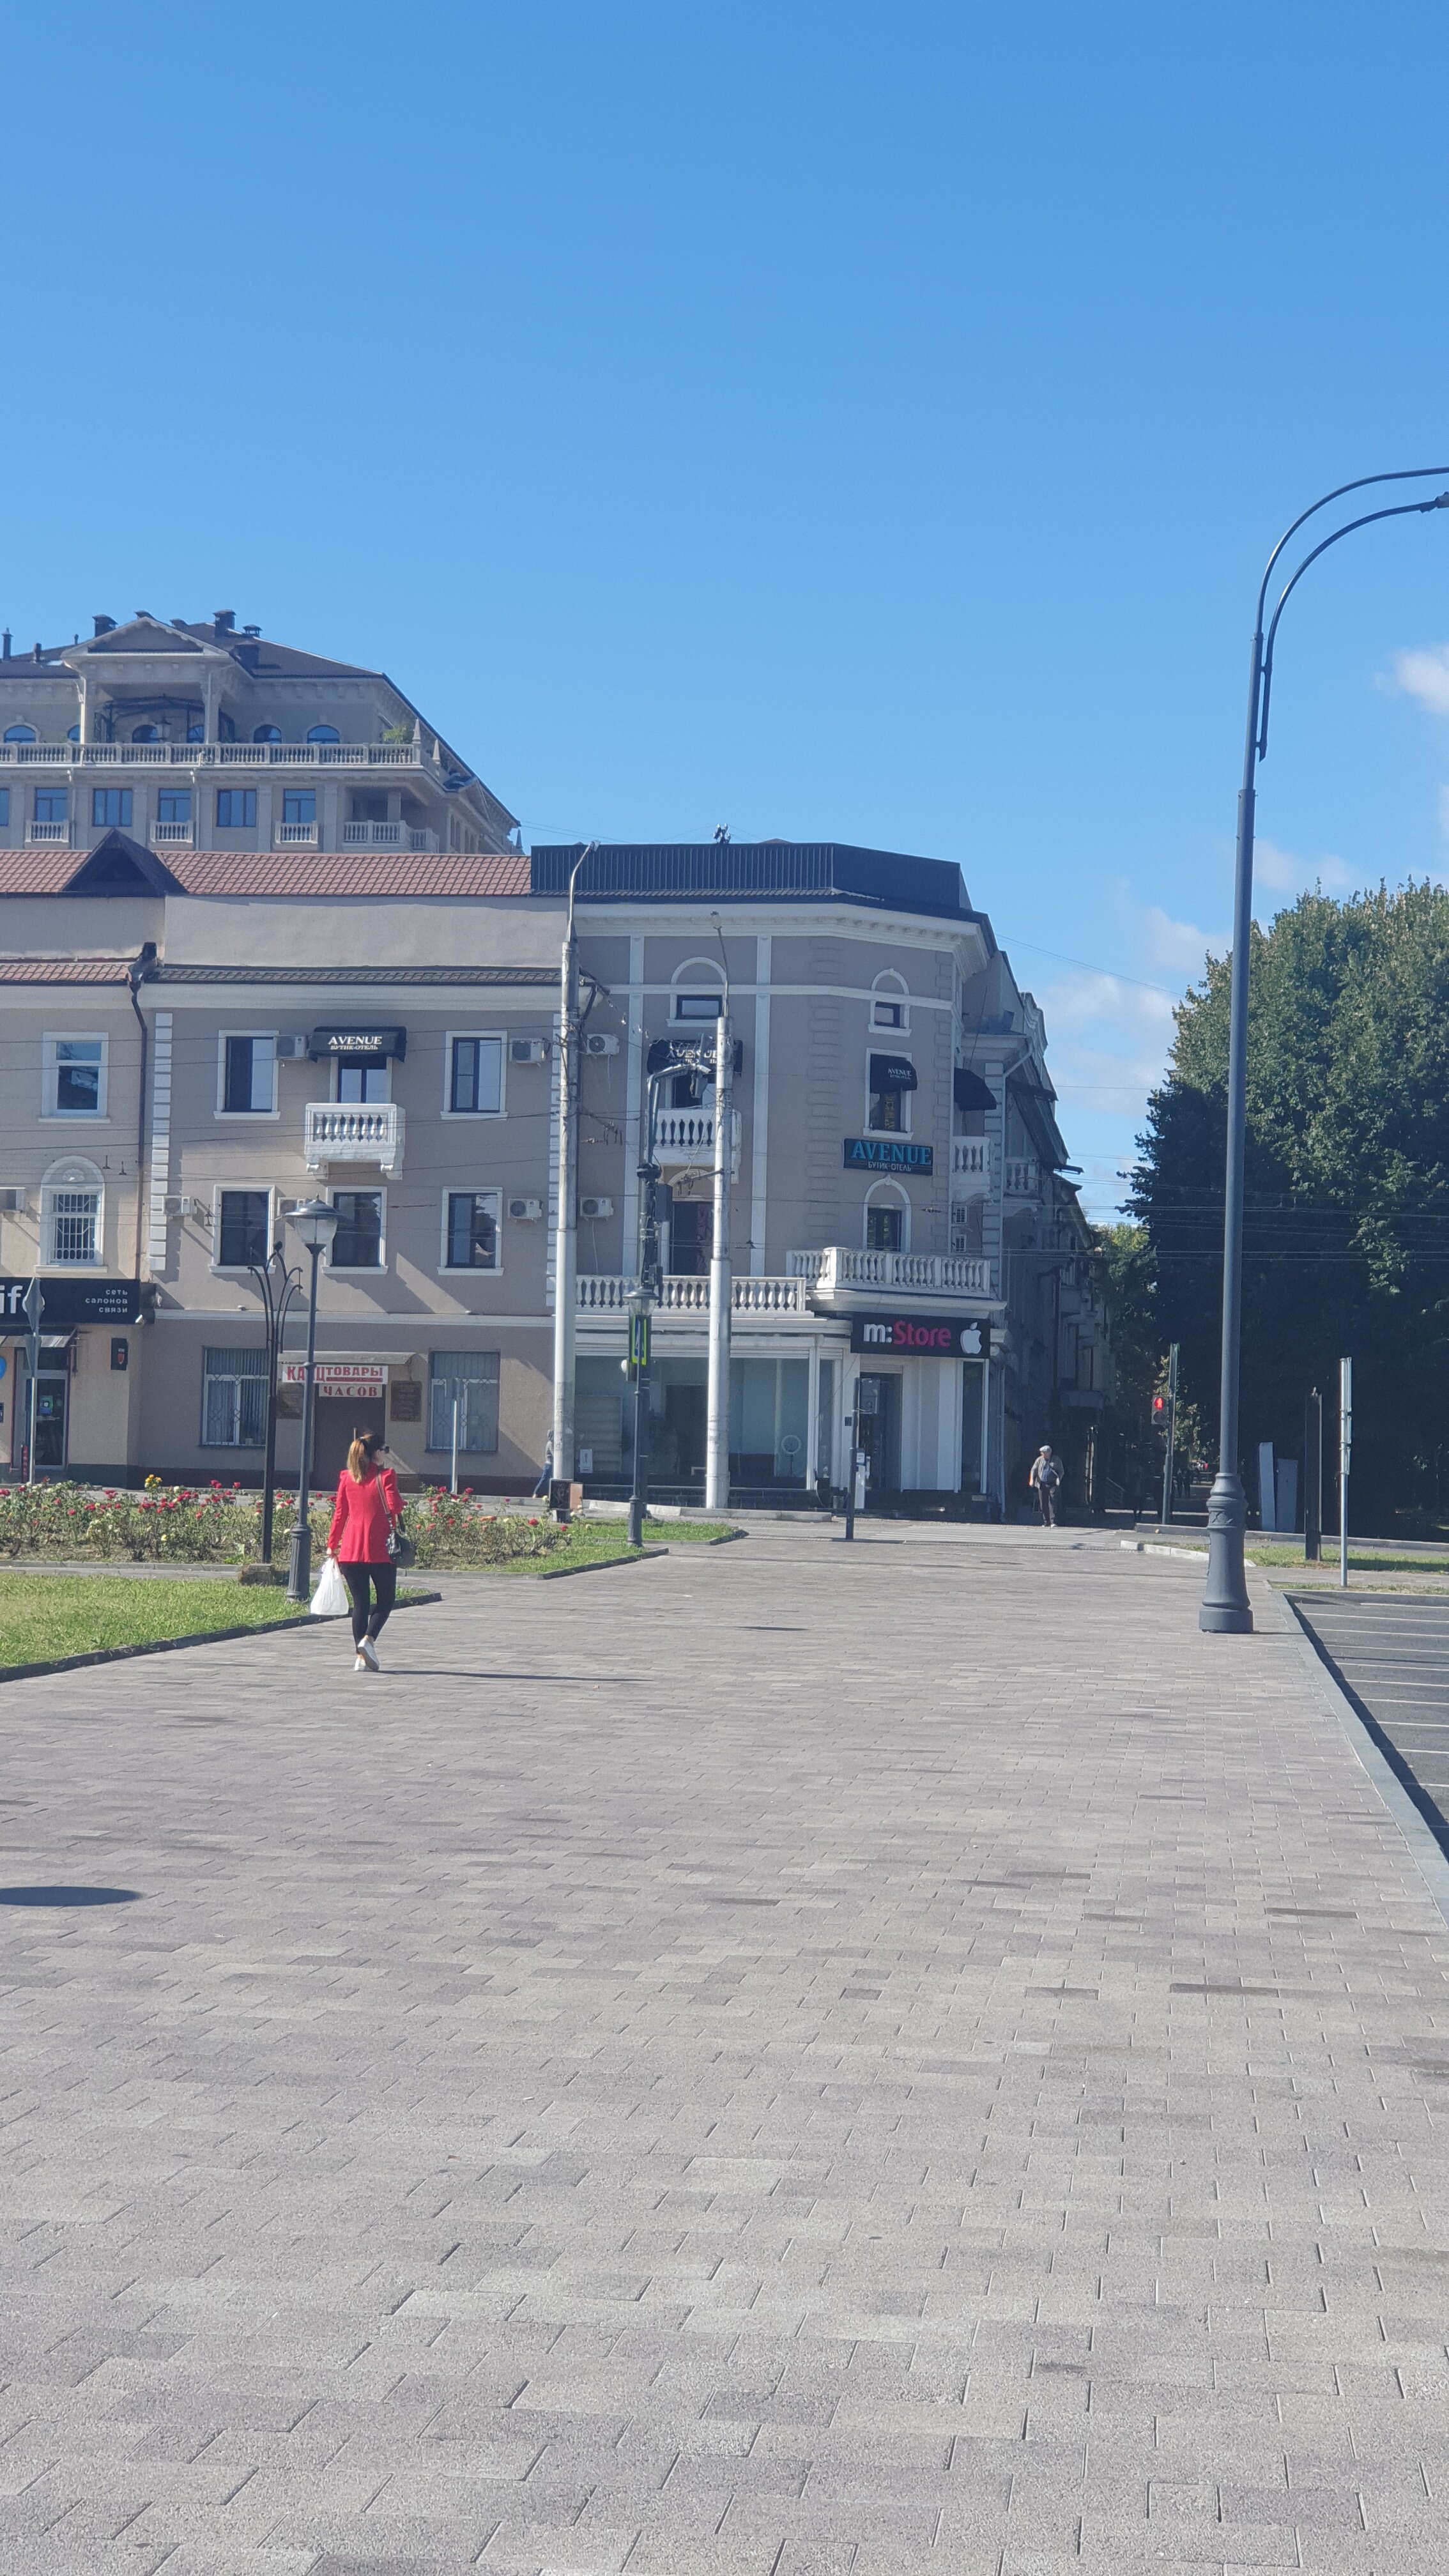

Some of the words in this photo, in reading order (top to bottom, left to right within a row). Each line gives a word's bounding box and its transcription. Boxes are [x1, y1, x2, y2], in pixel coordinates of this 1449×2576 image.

[328, 1036, 383, 1045] AVENUE
[887, 1068, 912, 1077] AVENUE
[852, 1141, 931, 1165] AVENUE
[868, 1161, 912, 1172] БУТИК-ОТЕЛЬ
[863, 1319, 952, 1347] m:Store
[287, 1366, 383, 1383] КАЦТОВАРЫ
[323, 1386, 378, 1397] ЧАСОВ
